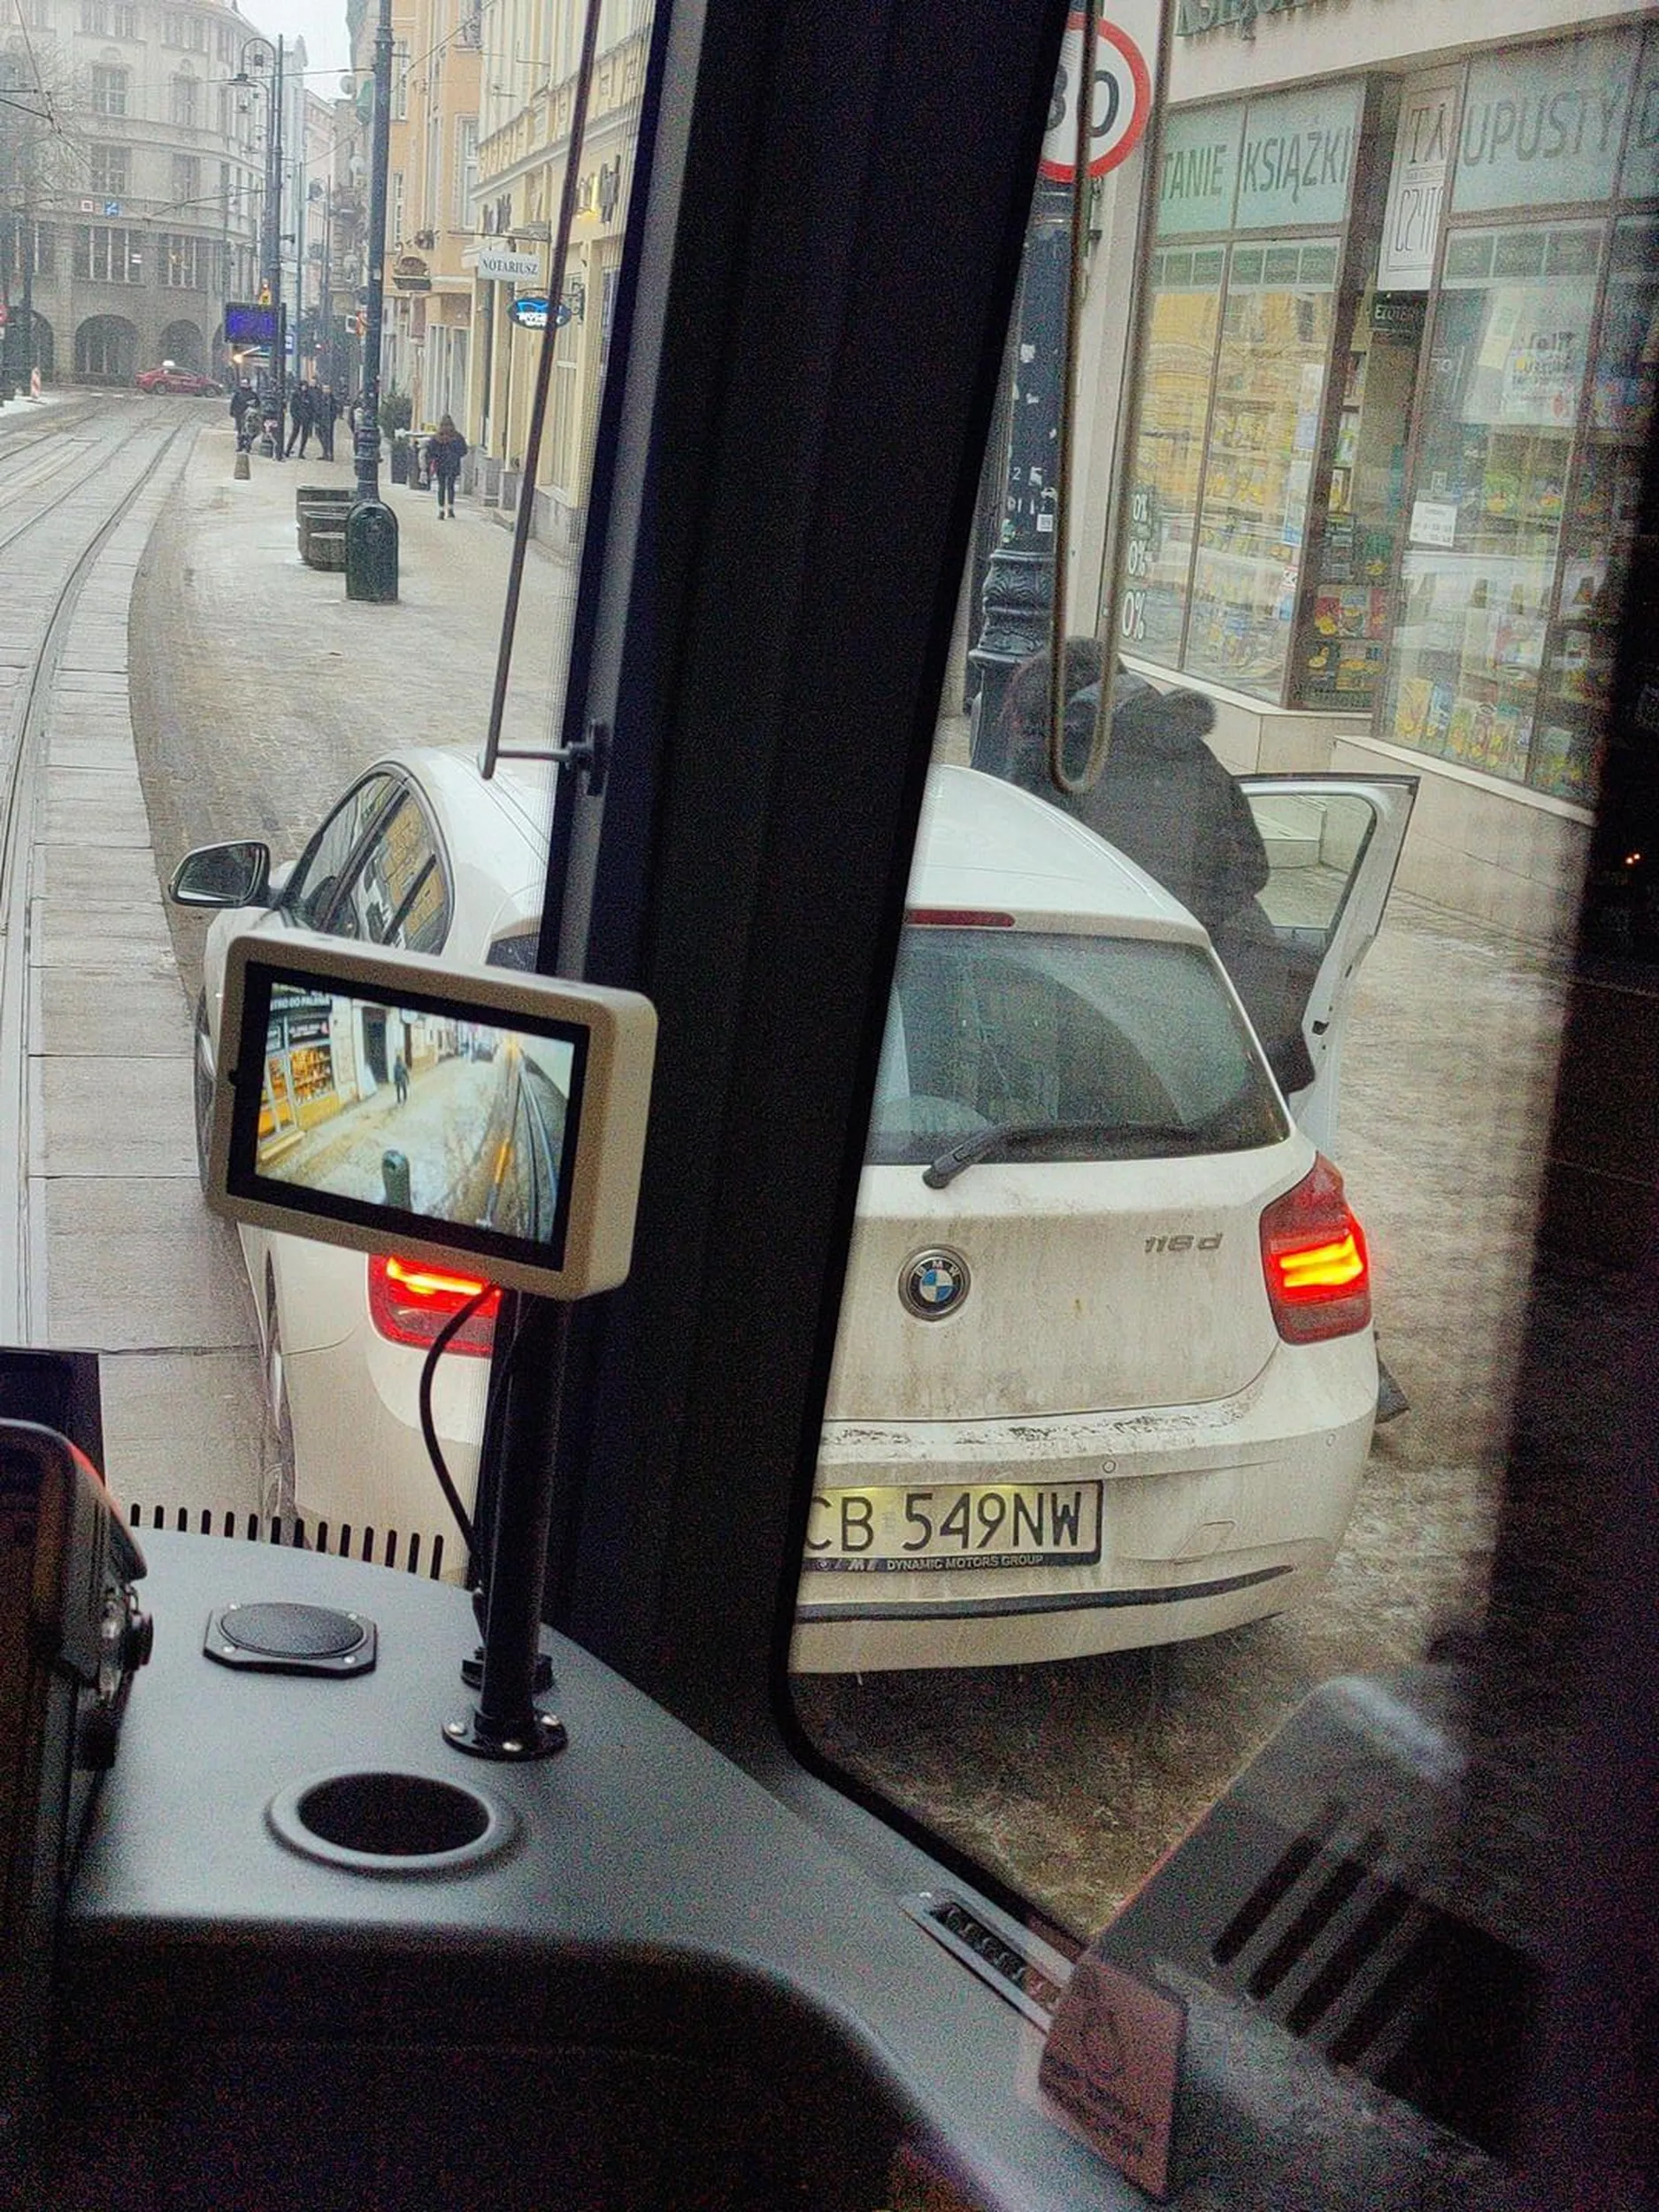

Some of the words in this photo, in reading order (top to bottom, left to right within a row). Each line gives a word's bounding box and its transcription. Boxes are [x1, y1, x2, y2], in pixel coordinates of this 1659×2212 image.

[1463, 84, 1622, 166] UPUSTY
[1162, 144, 1226, 200] TANIE
[1243, 116, 1355, 204] KSIĄŻKI
[483, 257, 538, 276] NOTARIUSZ
[806, 1496, 874, 1552] CB
[901, 1491, 1082, 1551] 549NW
[887, 1558, 942, 1571] DYNAMIC
[946, 1556, 999, 1569] MOTORS
[1001, 1555, 1043, 1566] GROUP
